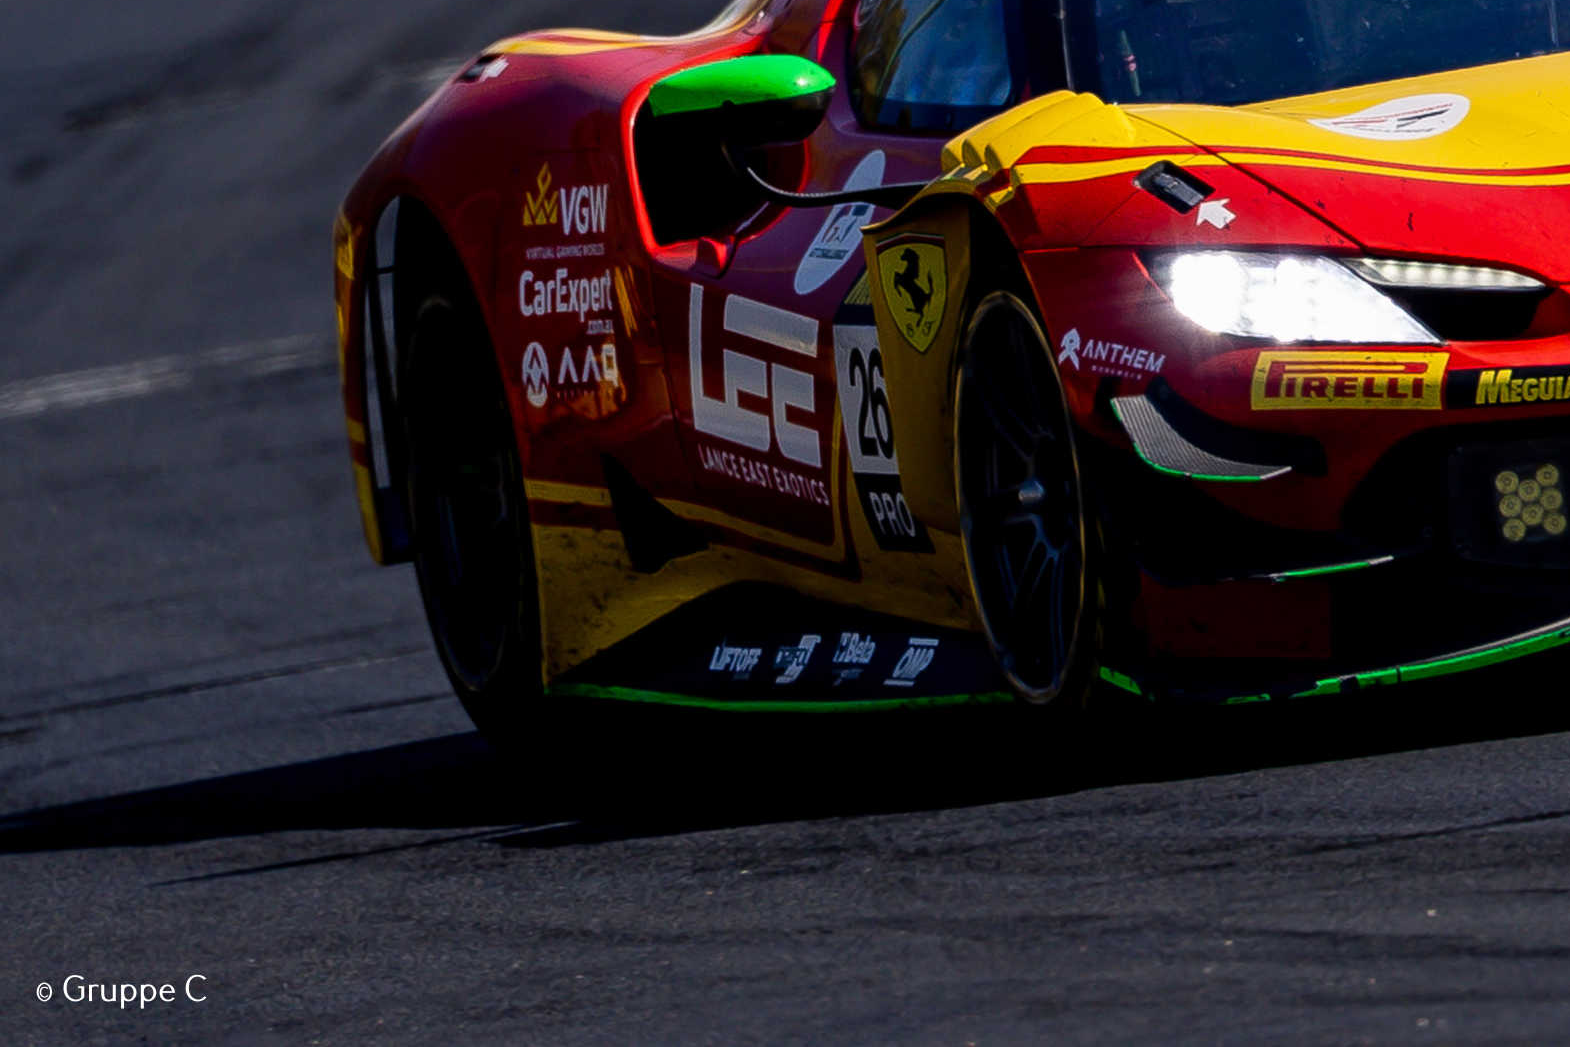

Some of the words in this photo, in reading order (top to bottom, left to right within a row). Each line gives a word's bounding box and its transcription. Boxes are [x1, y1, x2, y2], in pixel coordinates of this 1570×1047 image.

[560, 184, 609, 236] VGW
[519, 267, 613, 323] CarExpert
[688, 282, 823, 468] LEE
[1081, 338, 1167, 374] ANTHEM
[1264, 361, 1429, 400] PIRELLI
[849, 347, 895, 460] 26
[697, 442, 741, 480] LANCE
[740, 456, 774, 490] EAST
[772, 466, 831, 506] EXOTICS
[868, 490, 917, 538] PRO
